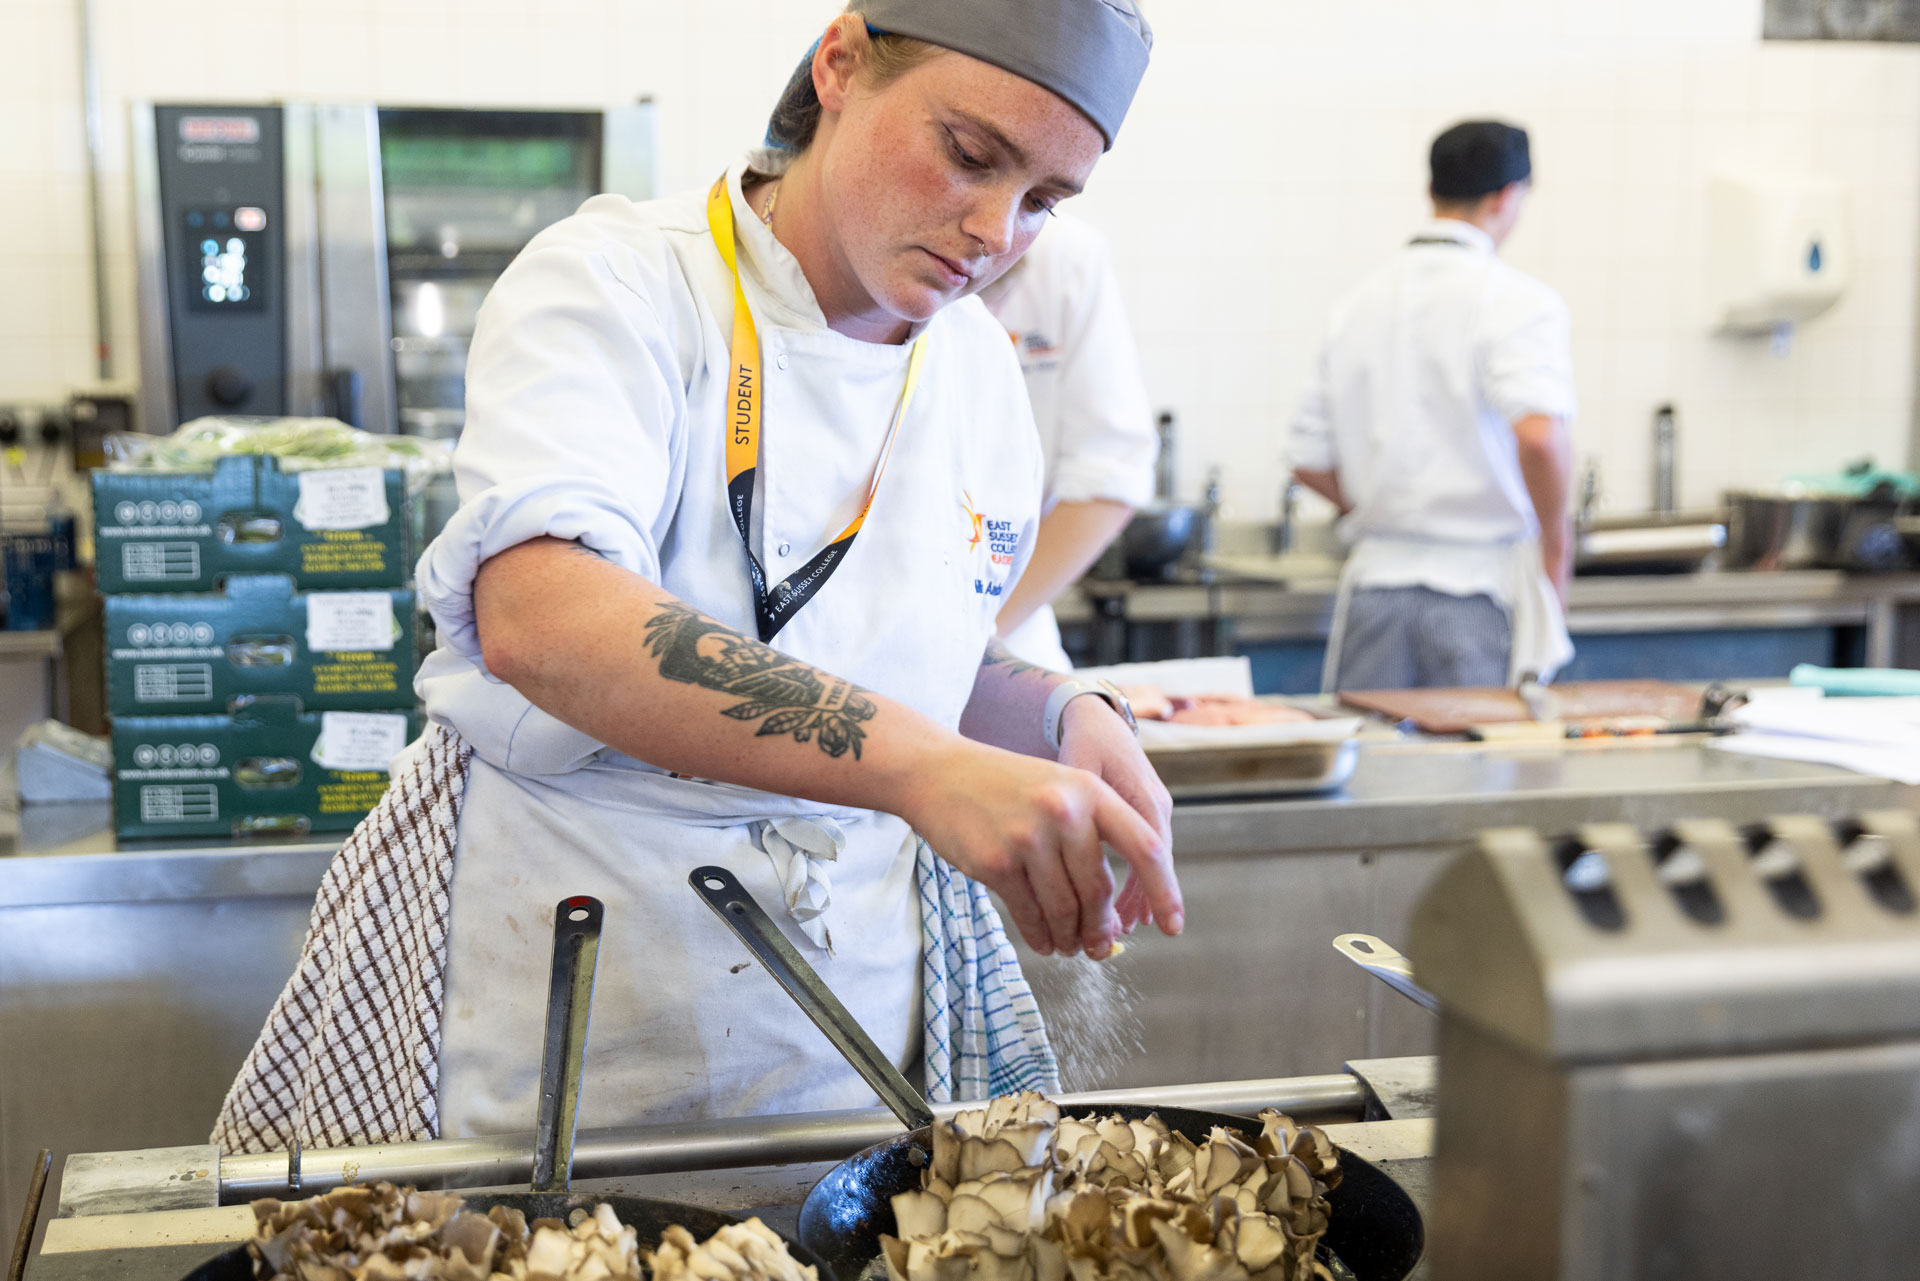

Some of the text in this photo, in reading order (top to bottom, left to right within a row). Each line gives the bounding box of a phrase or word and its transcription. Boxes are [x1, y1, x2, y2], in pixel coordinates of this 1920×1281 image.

[735, 363, 752, 445] STUDENT
[987, 520, 1011, 531] EAST
[775, 549, 838, 613] EAST SUSSEX COLLEGE
